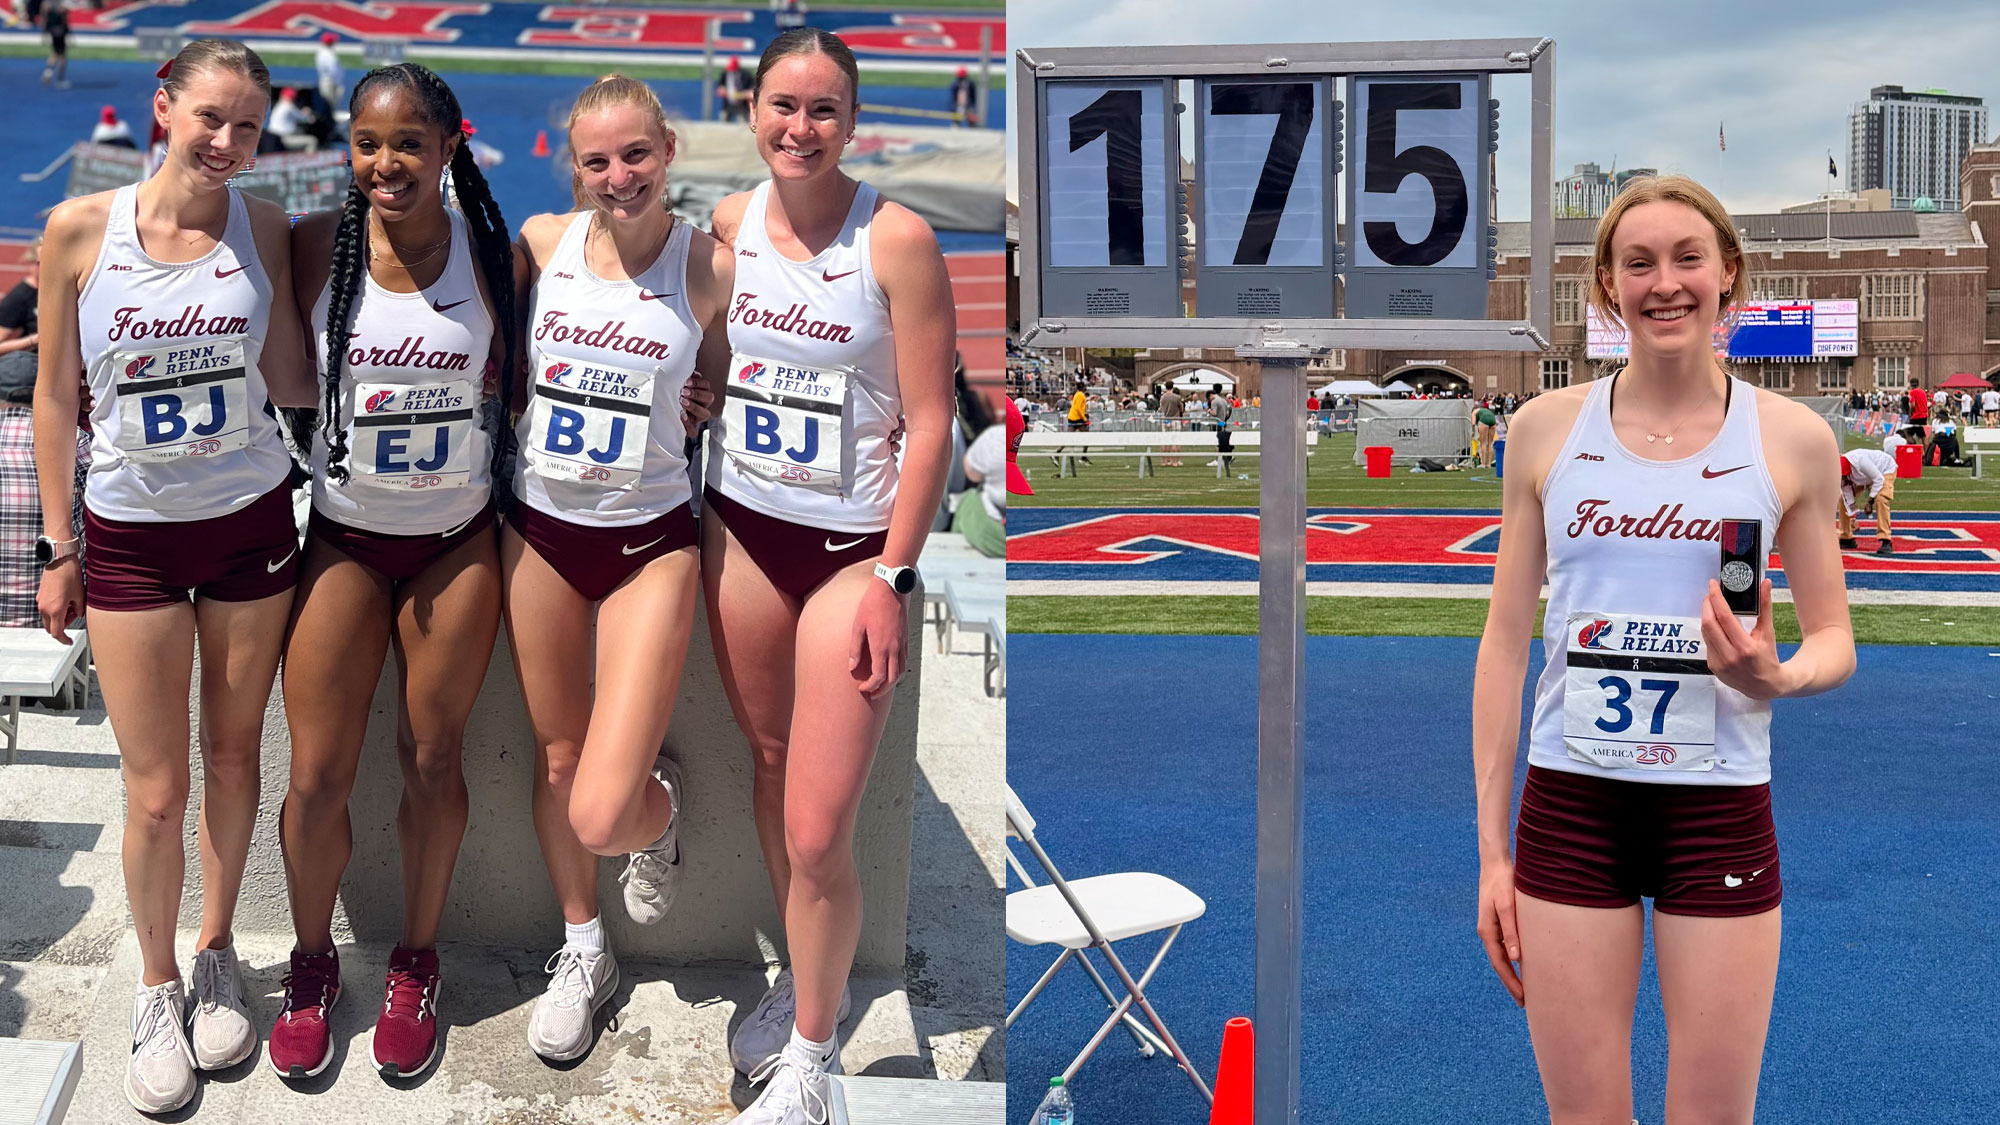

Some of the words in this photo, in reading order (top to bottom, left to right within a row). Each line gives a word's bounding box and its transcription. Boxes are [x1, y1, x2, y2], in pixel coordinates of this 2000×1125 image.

[108, 304, 250, 342] Fordham
[729, 292, 855, 344] Fordham
[535, 310, 670, 361] Fordham
[167, 345, 216, 363] PENN
[344, 333, 471, 371] ordham
[165, 355, 231, 375] RELAYS
[776, 366, 820, 383] PENN
[582, 367, 628, 384] PENN
[406, 386, 451, 400] PENN
[577, 378, 640, 398] RELAYS
[772, 378, 831, 397] RELAYS
[402, 396, 463, 411] RELAYS
[141, 385, 227, 445] BJ
[545, 405, 627, 464] BJ
[745, 404, 819, 464] BJ
[151, 449, 187, 458] AMERICA
[188, 439, 222, 457] 250
[376, 426, 450, 474] EJ
[545, 461, 578, 475] AMERICA
[579, 465, 611, 481] 250
[748, 461, 779, 474] AMERICA
[780, 464, 812, 482] 250
[375, 478, 409, 486] AMERICA
[410, 474, 442, 489] 250
[1625, 621, 1683, 638] PENN
[1620, 637, 1701, 654] RELAYS
[1594, 675, 1680, 735] 37
[1591, 748, 1634, 759] AMERICA
[1636, 745, 1677, 766] 250
